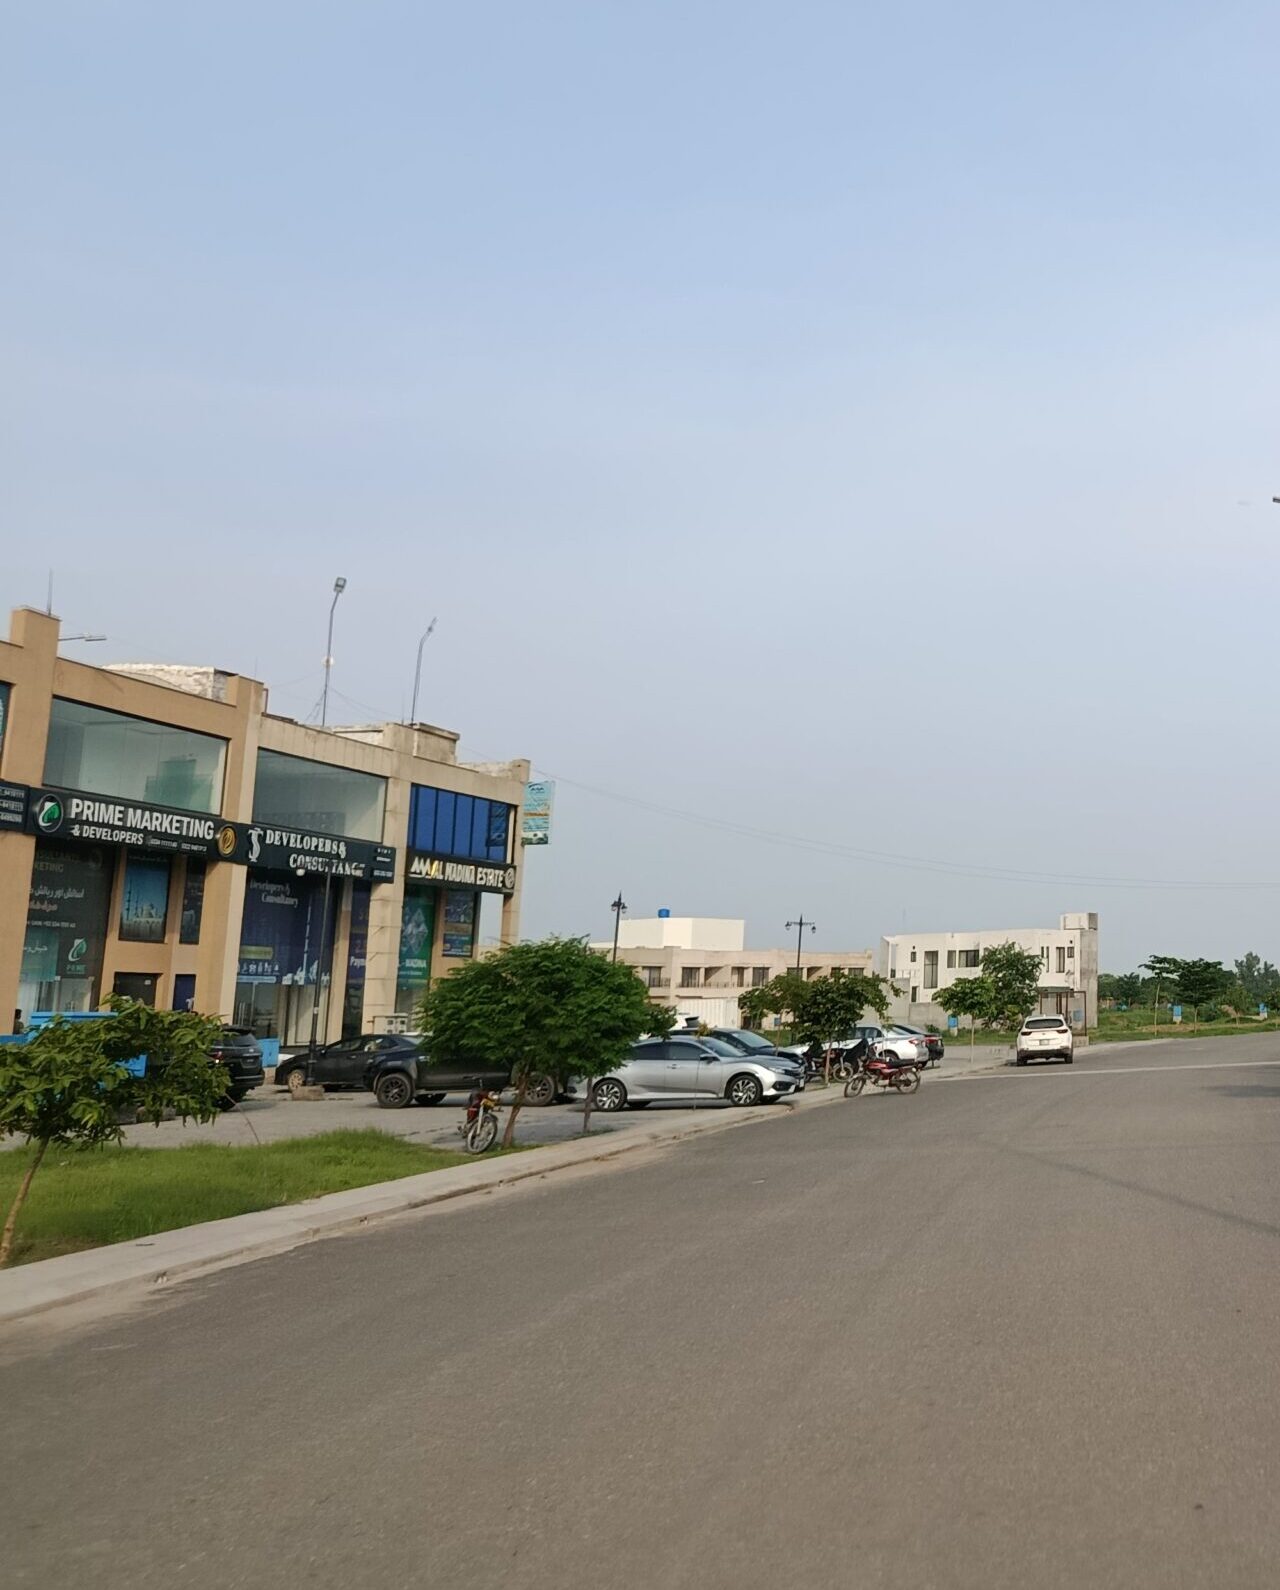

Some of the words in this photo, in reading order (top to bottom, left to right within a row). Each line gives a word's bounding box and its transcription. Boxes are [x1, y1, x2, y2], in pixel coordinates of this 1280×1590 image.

[70, 799, 125, 825] PRIME
[127, 808, 214, 840] MARKETING
[71, 824, 80, 836] &
[82, 825, 144, 845] DEVELOPERS
[476, 867, 505, 888] ESTATE
